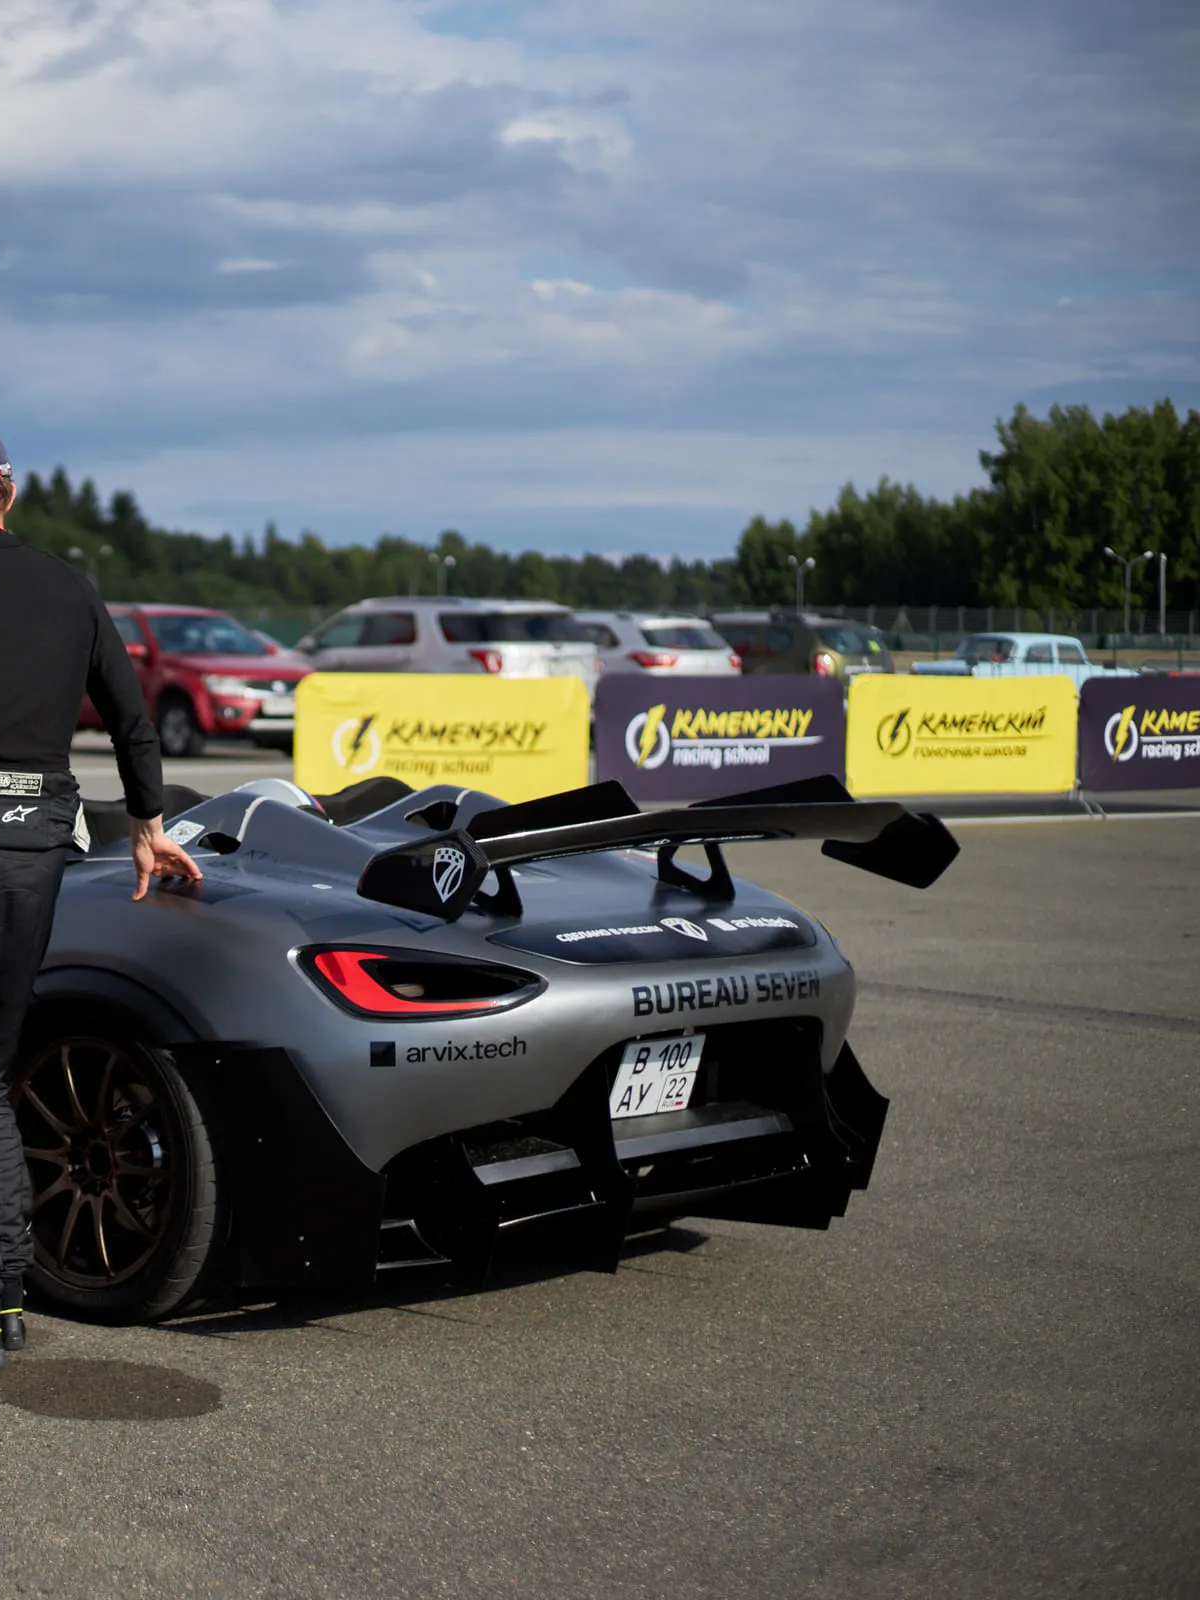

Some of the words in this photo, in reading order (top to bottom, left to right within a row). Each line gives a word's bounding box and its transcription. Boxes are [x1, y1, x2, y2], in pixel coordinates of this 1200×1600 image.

[385, 719, 547, 748] KAMENSKIY
[671, 707, 814, 738] KAMENSKIY
[916, 705, 1047, 735] КАМЕНСКИЙ
[384, 755, 436, 775] racing
[442, 753, 494, 773] school
[672, 745, 722, 769] racing
[724, 744, 771, 765] school
[1141, 739, 1182, 761] racing
[632, 975, 749, 1017] BUREAU
[753, 969, 820, 1004] SEVEN
[406, 1036, 527, 1063] arvix.tech
[658, 1041, 693, 1072] 100
[665, 1076, 687, 1099] 22
